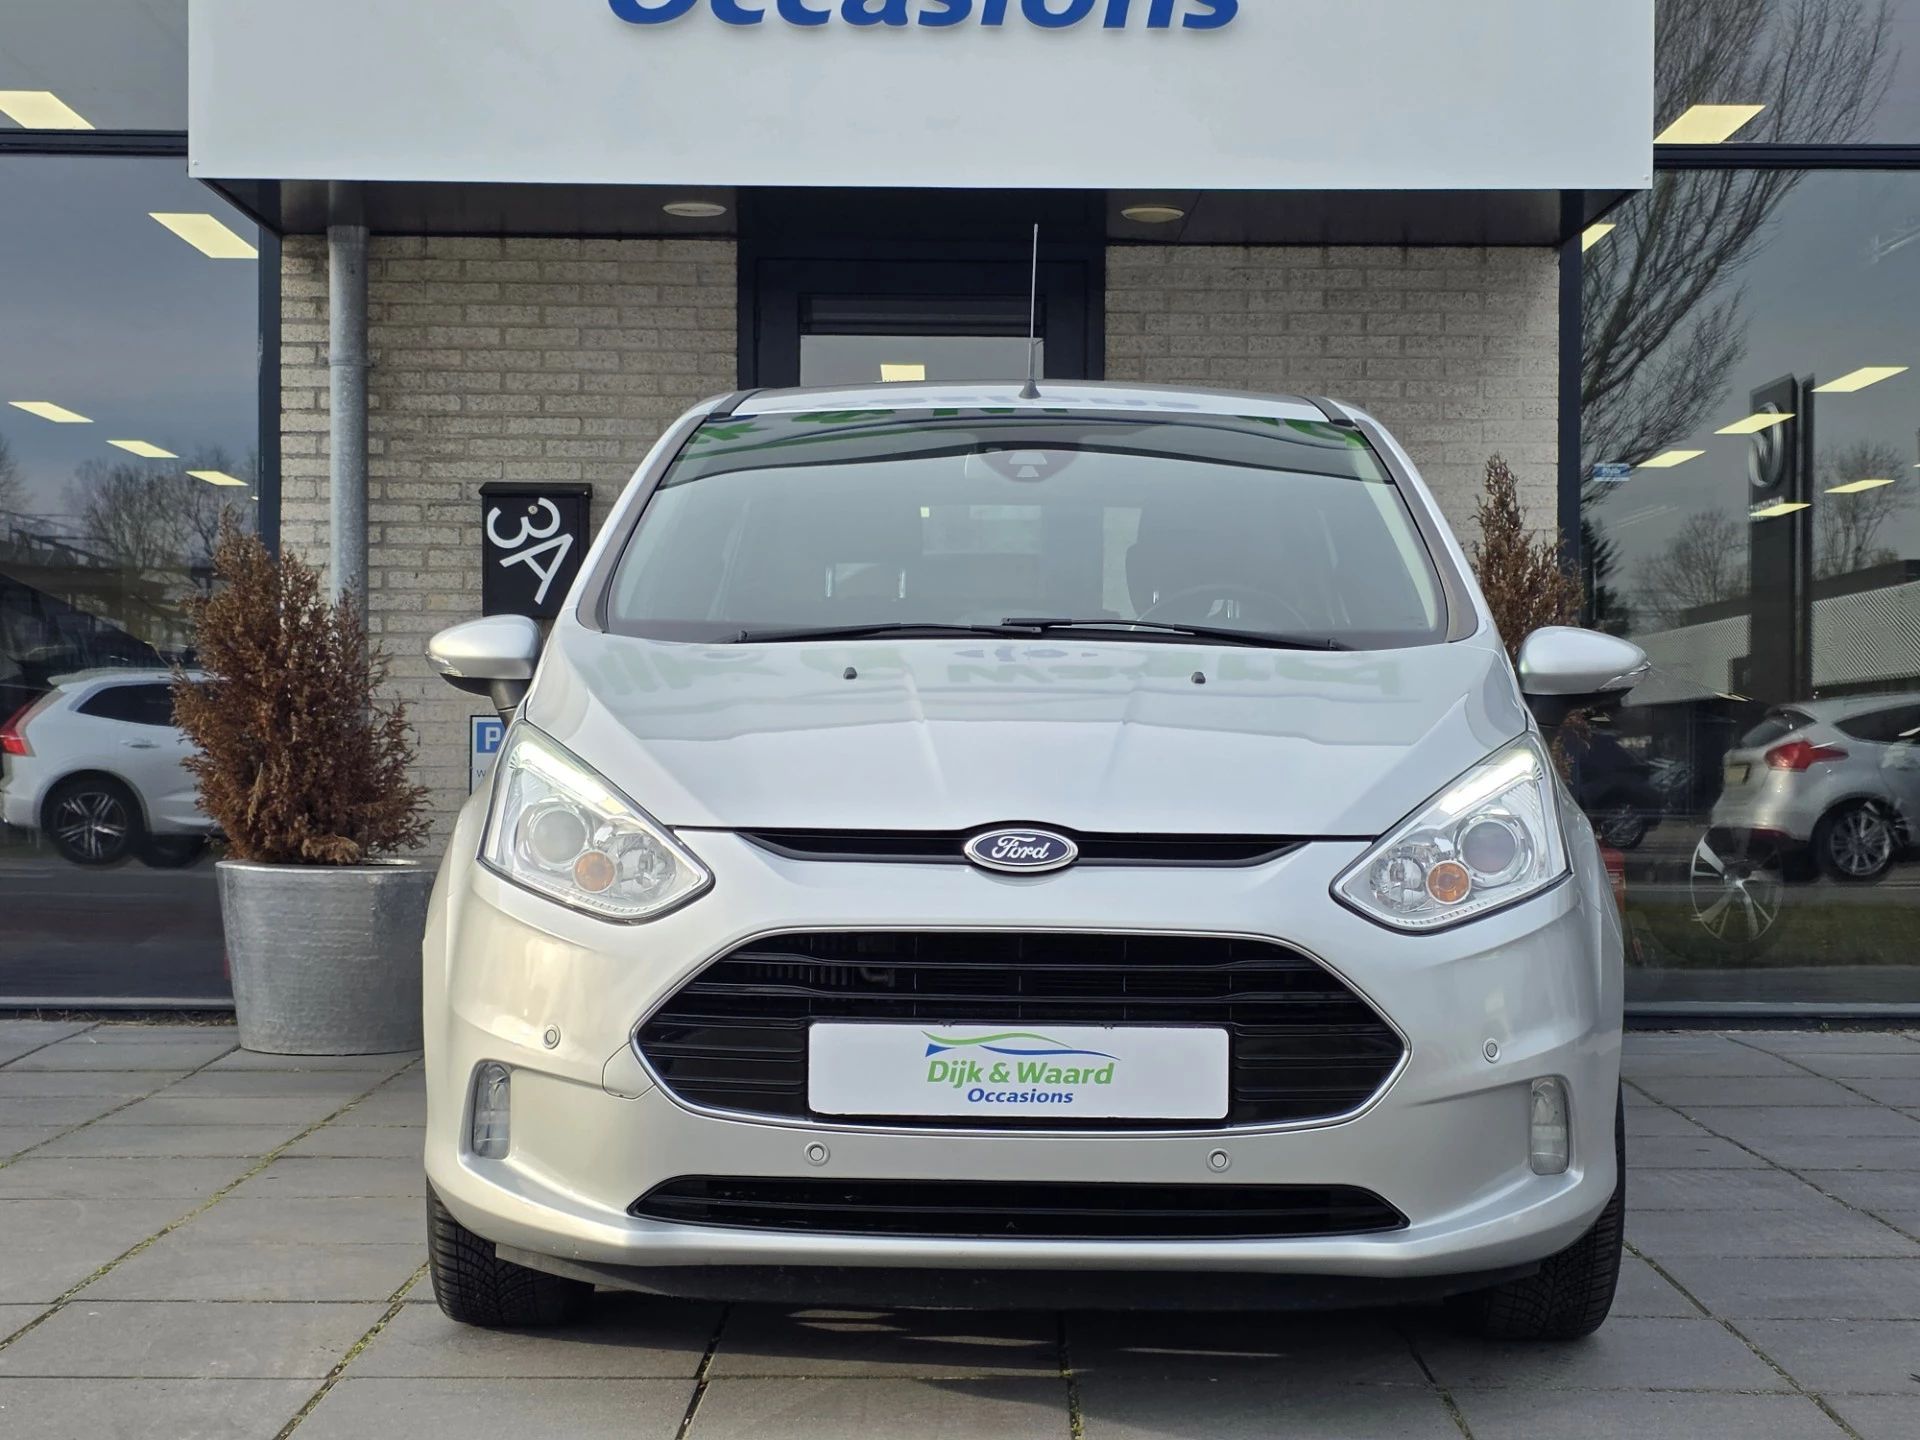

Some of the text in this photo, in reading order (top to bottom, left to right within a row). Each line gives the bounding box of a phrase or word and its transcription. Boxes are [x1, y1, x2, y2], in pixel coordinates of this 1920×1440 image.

[487, 498, 574, 605] 3A
[485, 727, 501, 750] P
[991, 836, 1051, 859] Ford
[926, 1059, 1114, 1089] Dijk & Waard
[967, 1087, 1074, 1104] Occasions
